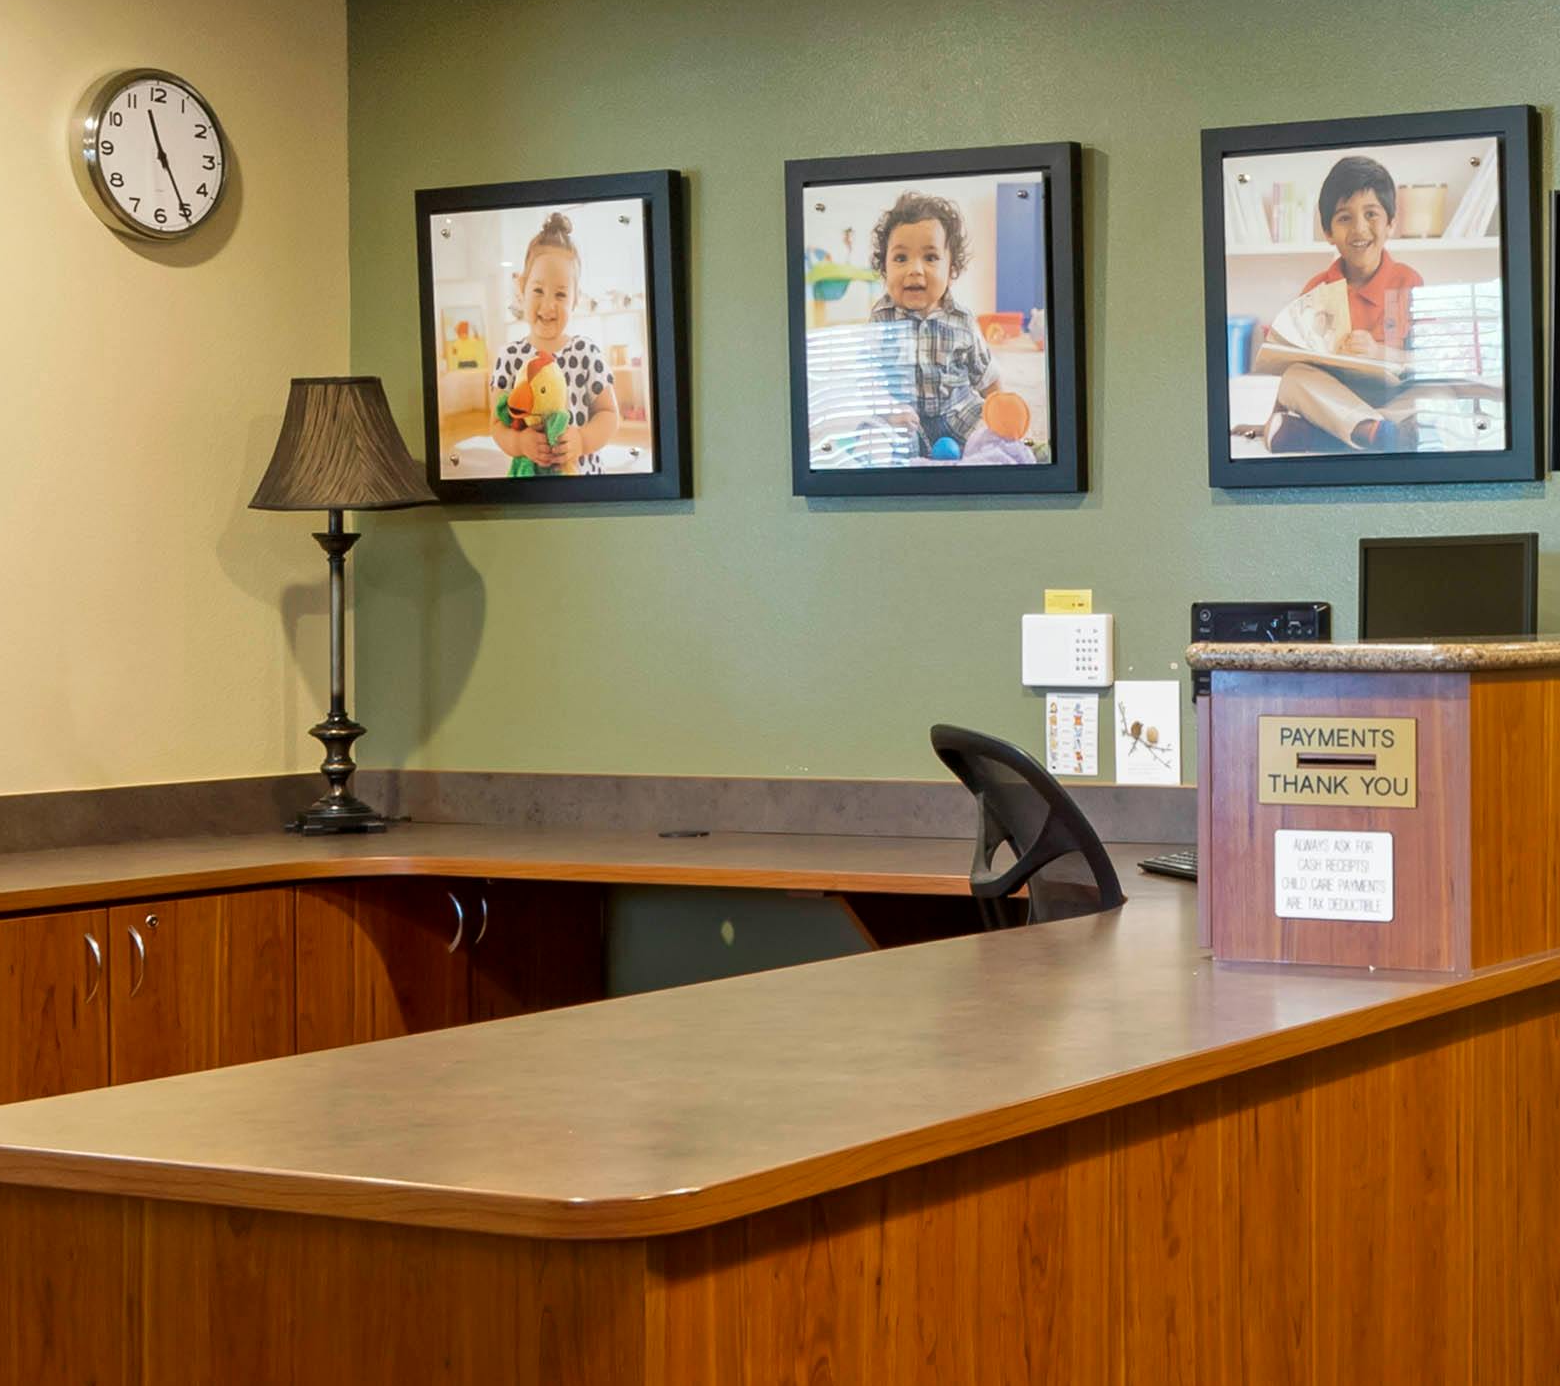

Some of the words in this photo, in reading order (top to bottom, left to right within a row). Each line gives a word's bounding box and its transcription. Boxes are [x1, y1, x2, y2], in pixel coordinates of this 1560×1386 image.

[127, 93, 137, 109] 11
[149, 87, 167, 103] 12
[181, 98, 186, 114] 1
[108, 111, 123, 127] 10
[194, 124, 208, 139] 2
[101, 140, 114, 156] 9
[202, 155, 216, 170] 3
[110, 172, 124, 188] 8
[196, 183, 209, 198] 4
[129, 197, 141, 213] 7
[154, 209, 167, 224] 6
[1280, 728, 1395, 748] PAYMENTS
[1268, 774, 1349, 795] THANK
[1360, 777, 1409, 796] YOU
[1293, 838, 1329, 853] ALWAYS
[1334, 840, 1351, 853] ASK
[1355, 840, 1374, 854] FOR
[1298, 858, 1322, 872] CASH
[1281, 877, 1307, 890] CHILD
[1311, 878, 1333, 891] CARE
[1338, 879, 1386, 893] PAYMENTS
[1286, 897, 1303, 910] ARE
[1308, 898, 1323, 910] TAX
[1328, 899, 1381, 913] DEDUCTIBLE
